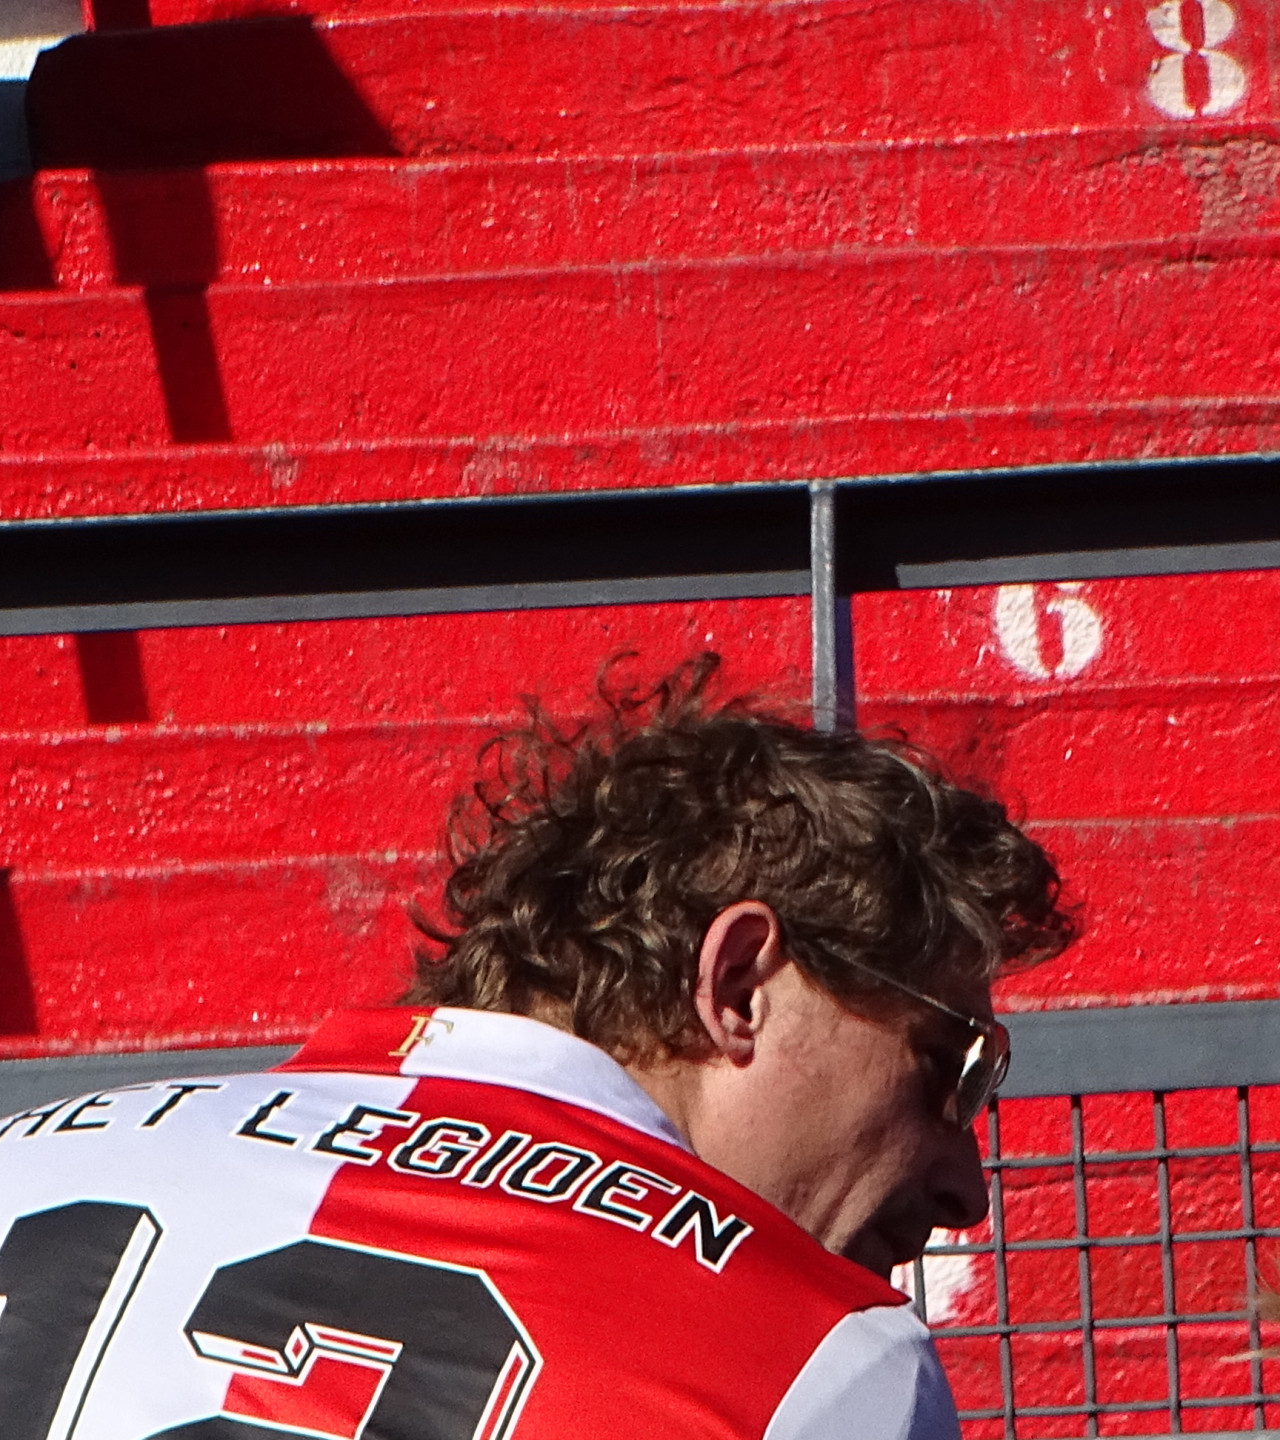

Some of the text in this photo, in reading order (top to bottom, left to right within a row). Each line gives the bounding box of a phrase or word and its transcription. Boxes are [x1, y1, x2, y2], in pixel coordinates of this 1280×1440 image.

[1146, 0, 1245, 120] 8
[993, 583, 1102, 682] 6
[388, 1014, 455, 1057] F
[234, 1089, 754, 1274] LEGIOEN
